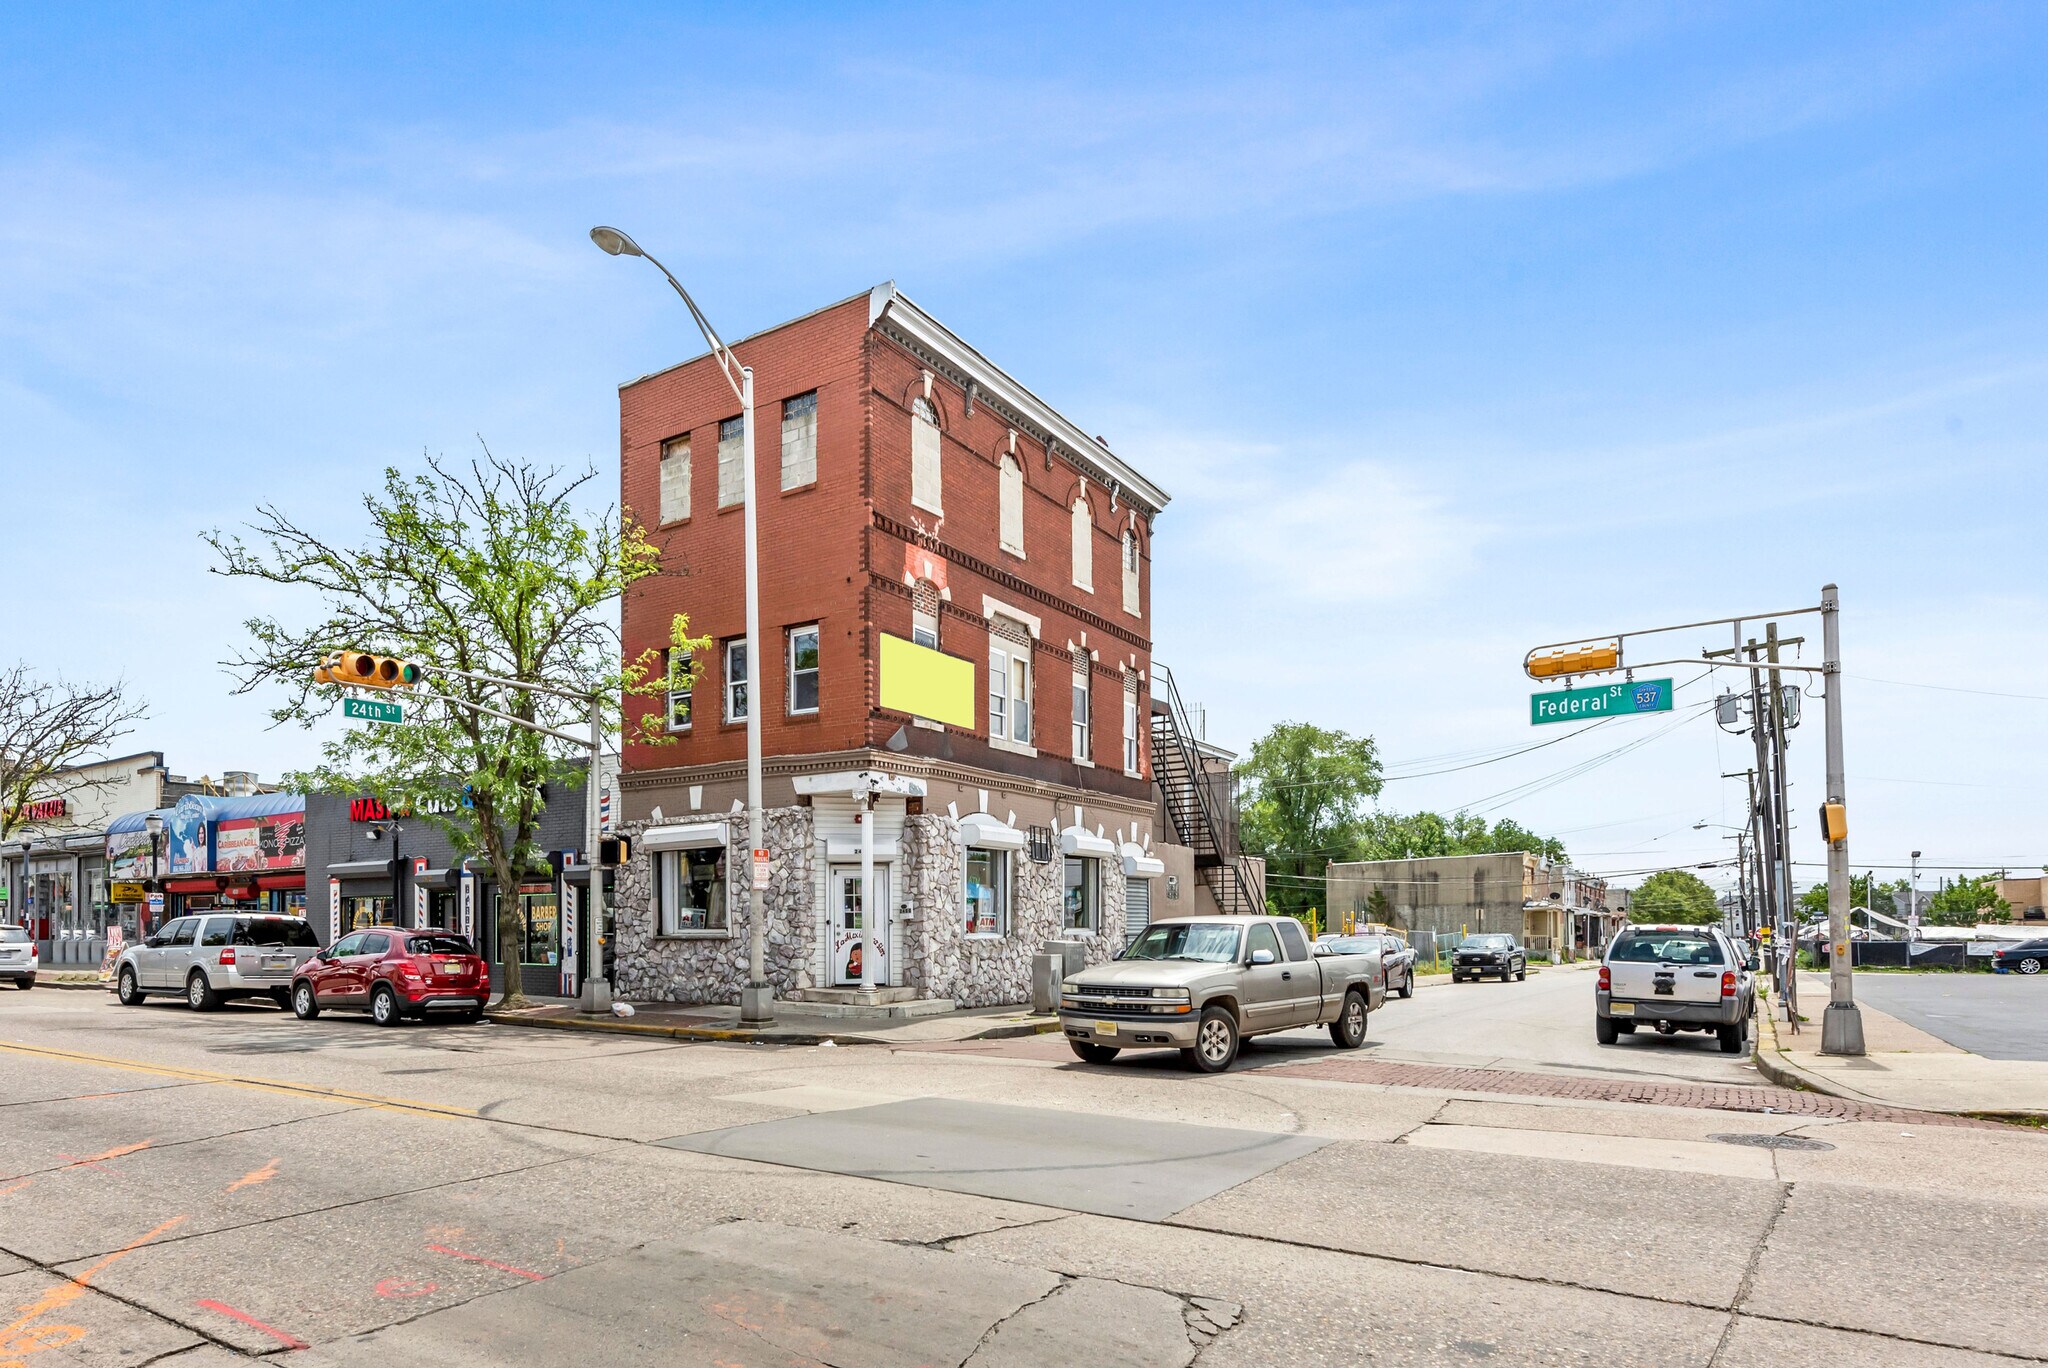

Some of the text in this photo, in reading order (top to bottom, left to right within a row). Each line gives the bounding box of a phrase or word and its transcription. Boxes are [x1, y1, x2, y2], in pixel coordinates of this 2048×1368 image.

[1539, 686, 1622, 717] Federal St
[1636, 691, 1657, 704] 537
[351, 702, 396, 718] 24th St
[31, 799, 66, 819] VALUE
[350, 797, 411, 822] MASR
[531, 906, 557, 920] BARBER
[535, 922, 552, 931] SHOP
[980, 917, 996, 926] ATM
